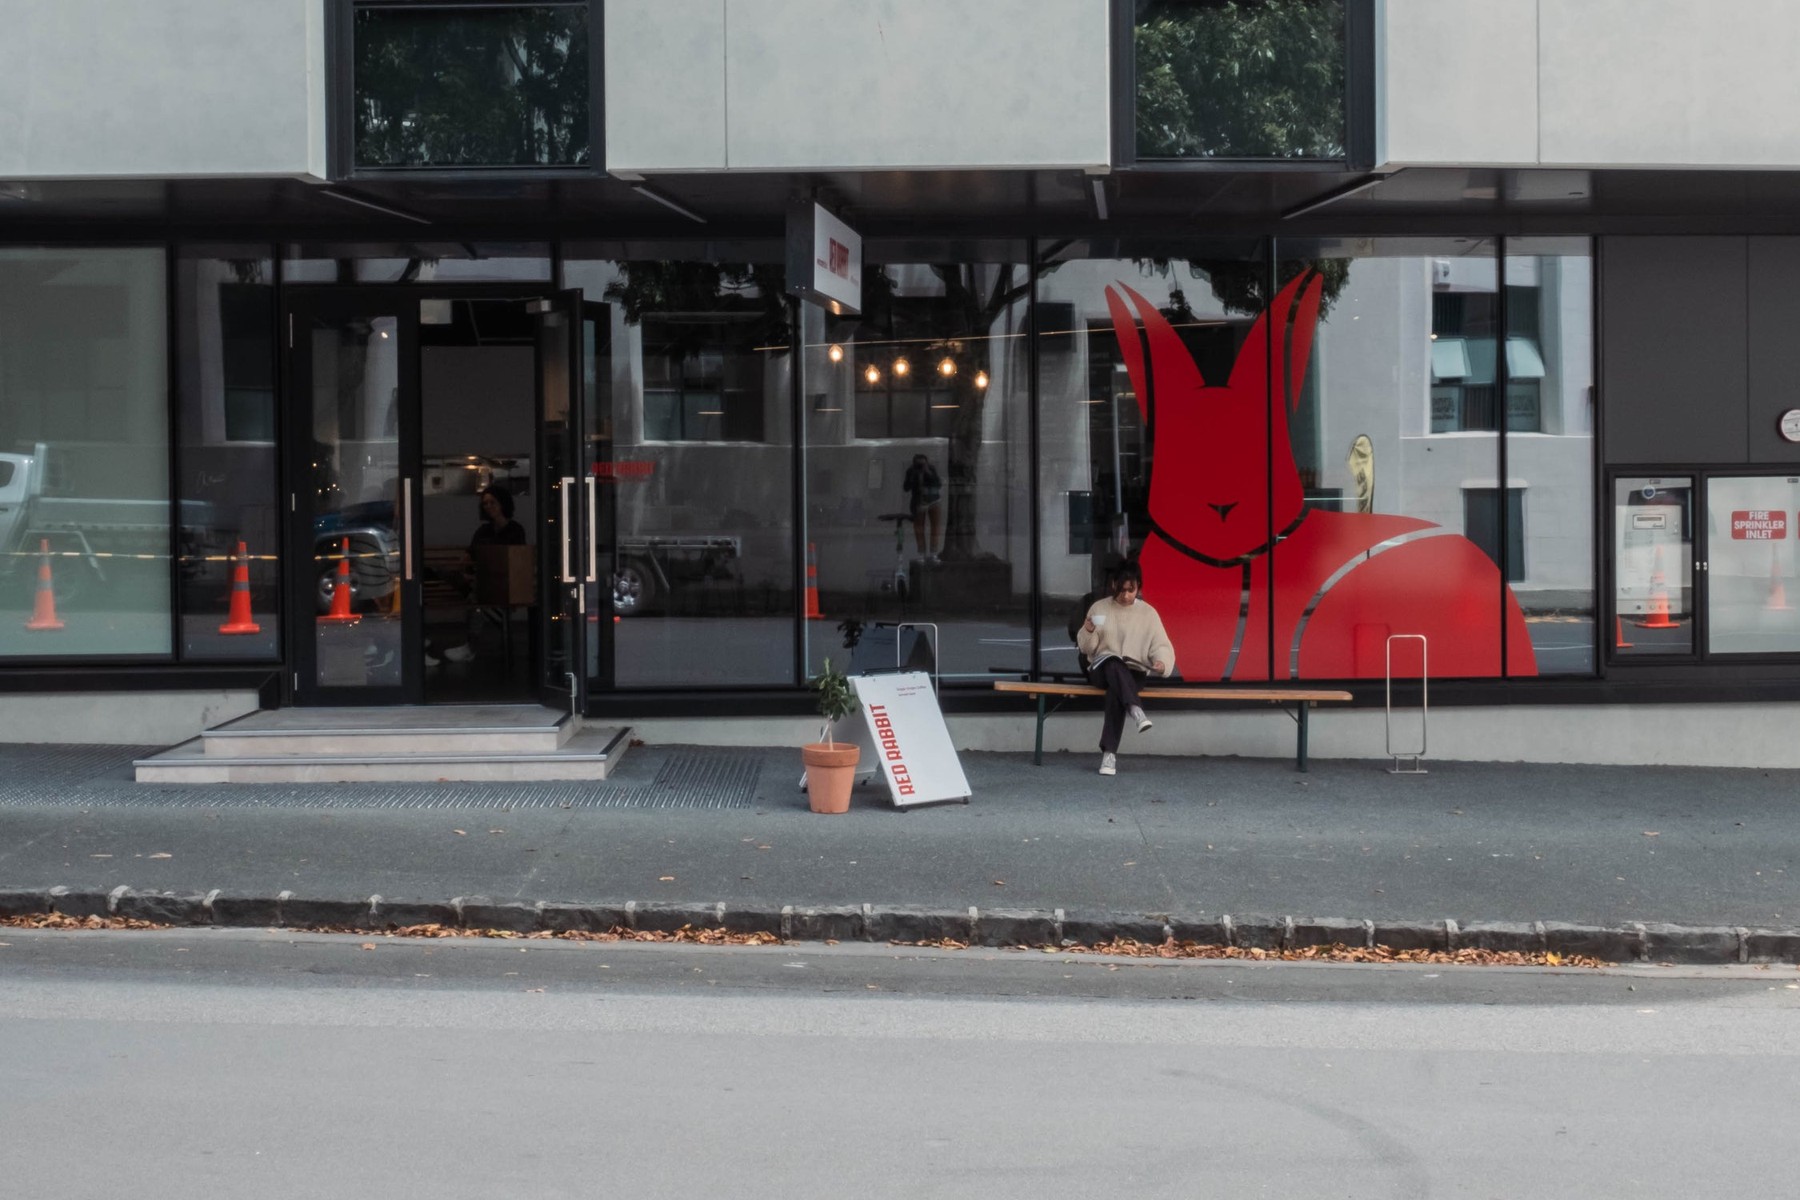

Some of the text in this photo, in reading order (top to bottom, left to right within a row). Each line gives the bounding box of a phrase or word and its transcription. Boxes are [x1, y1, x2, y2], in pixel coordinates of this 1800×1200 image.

[1749, 511, 1769, 520] FIRE
[1734, 520, 1785, 530] SPRINKLER
[1746, 529, 1772, 539] INLET
[869, 704, 915, 796] RED RABBIT
